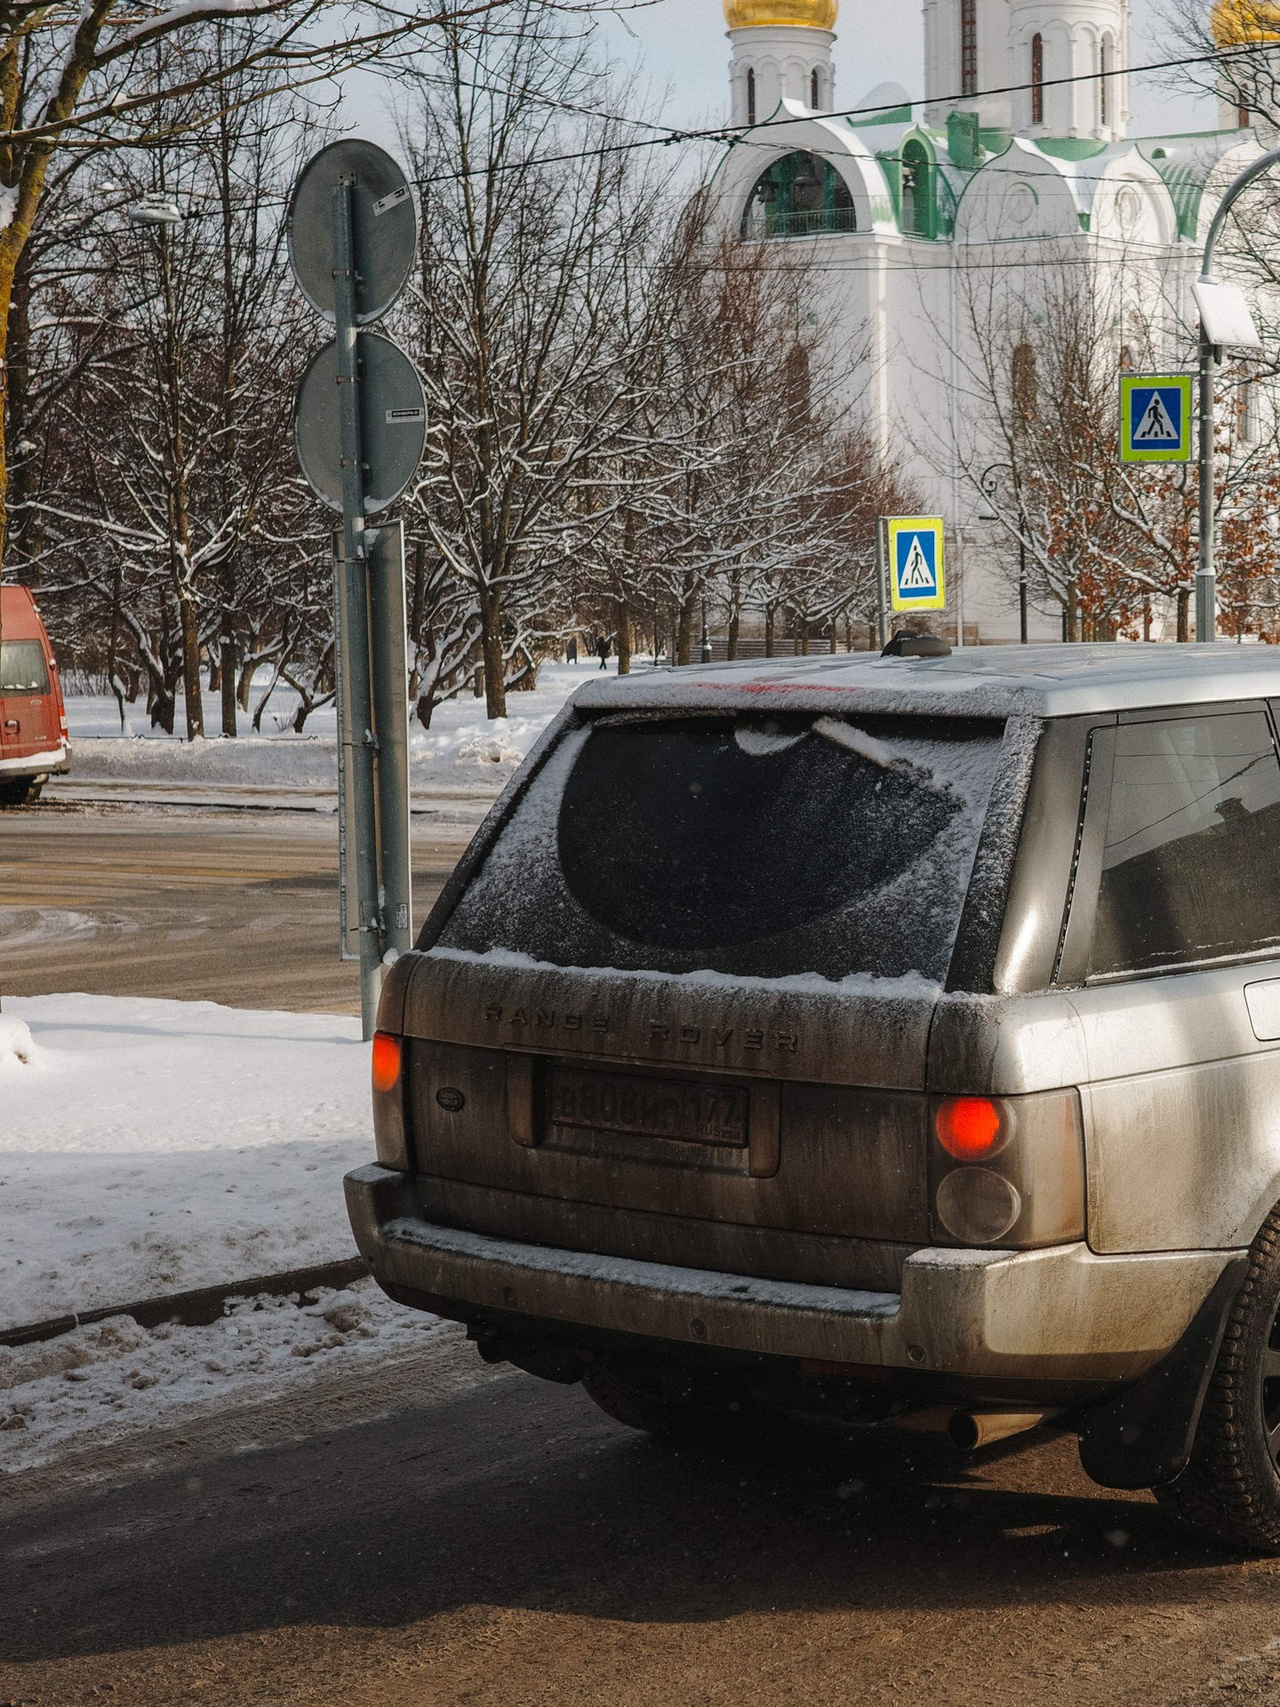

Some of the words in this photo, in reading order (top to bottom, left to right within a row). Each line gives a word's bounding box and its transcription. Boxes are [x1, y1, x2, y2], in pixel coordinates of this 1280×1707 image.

[484, 1001, 609, 1033] RANGE
[647, 1018, 799, 1054] ROVER
[696, 1124, 722, 1138] RUS
